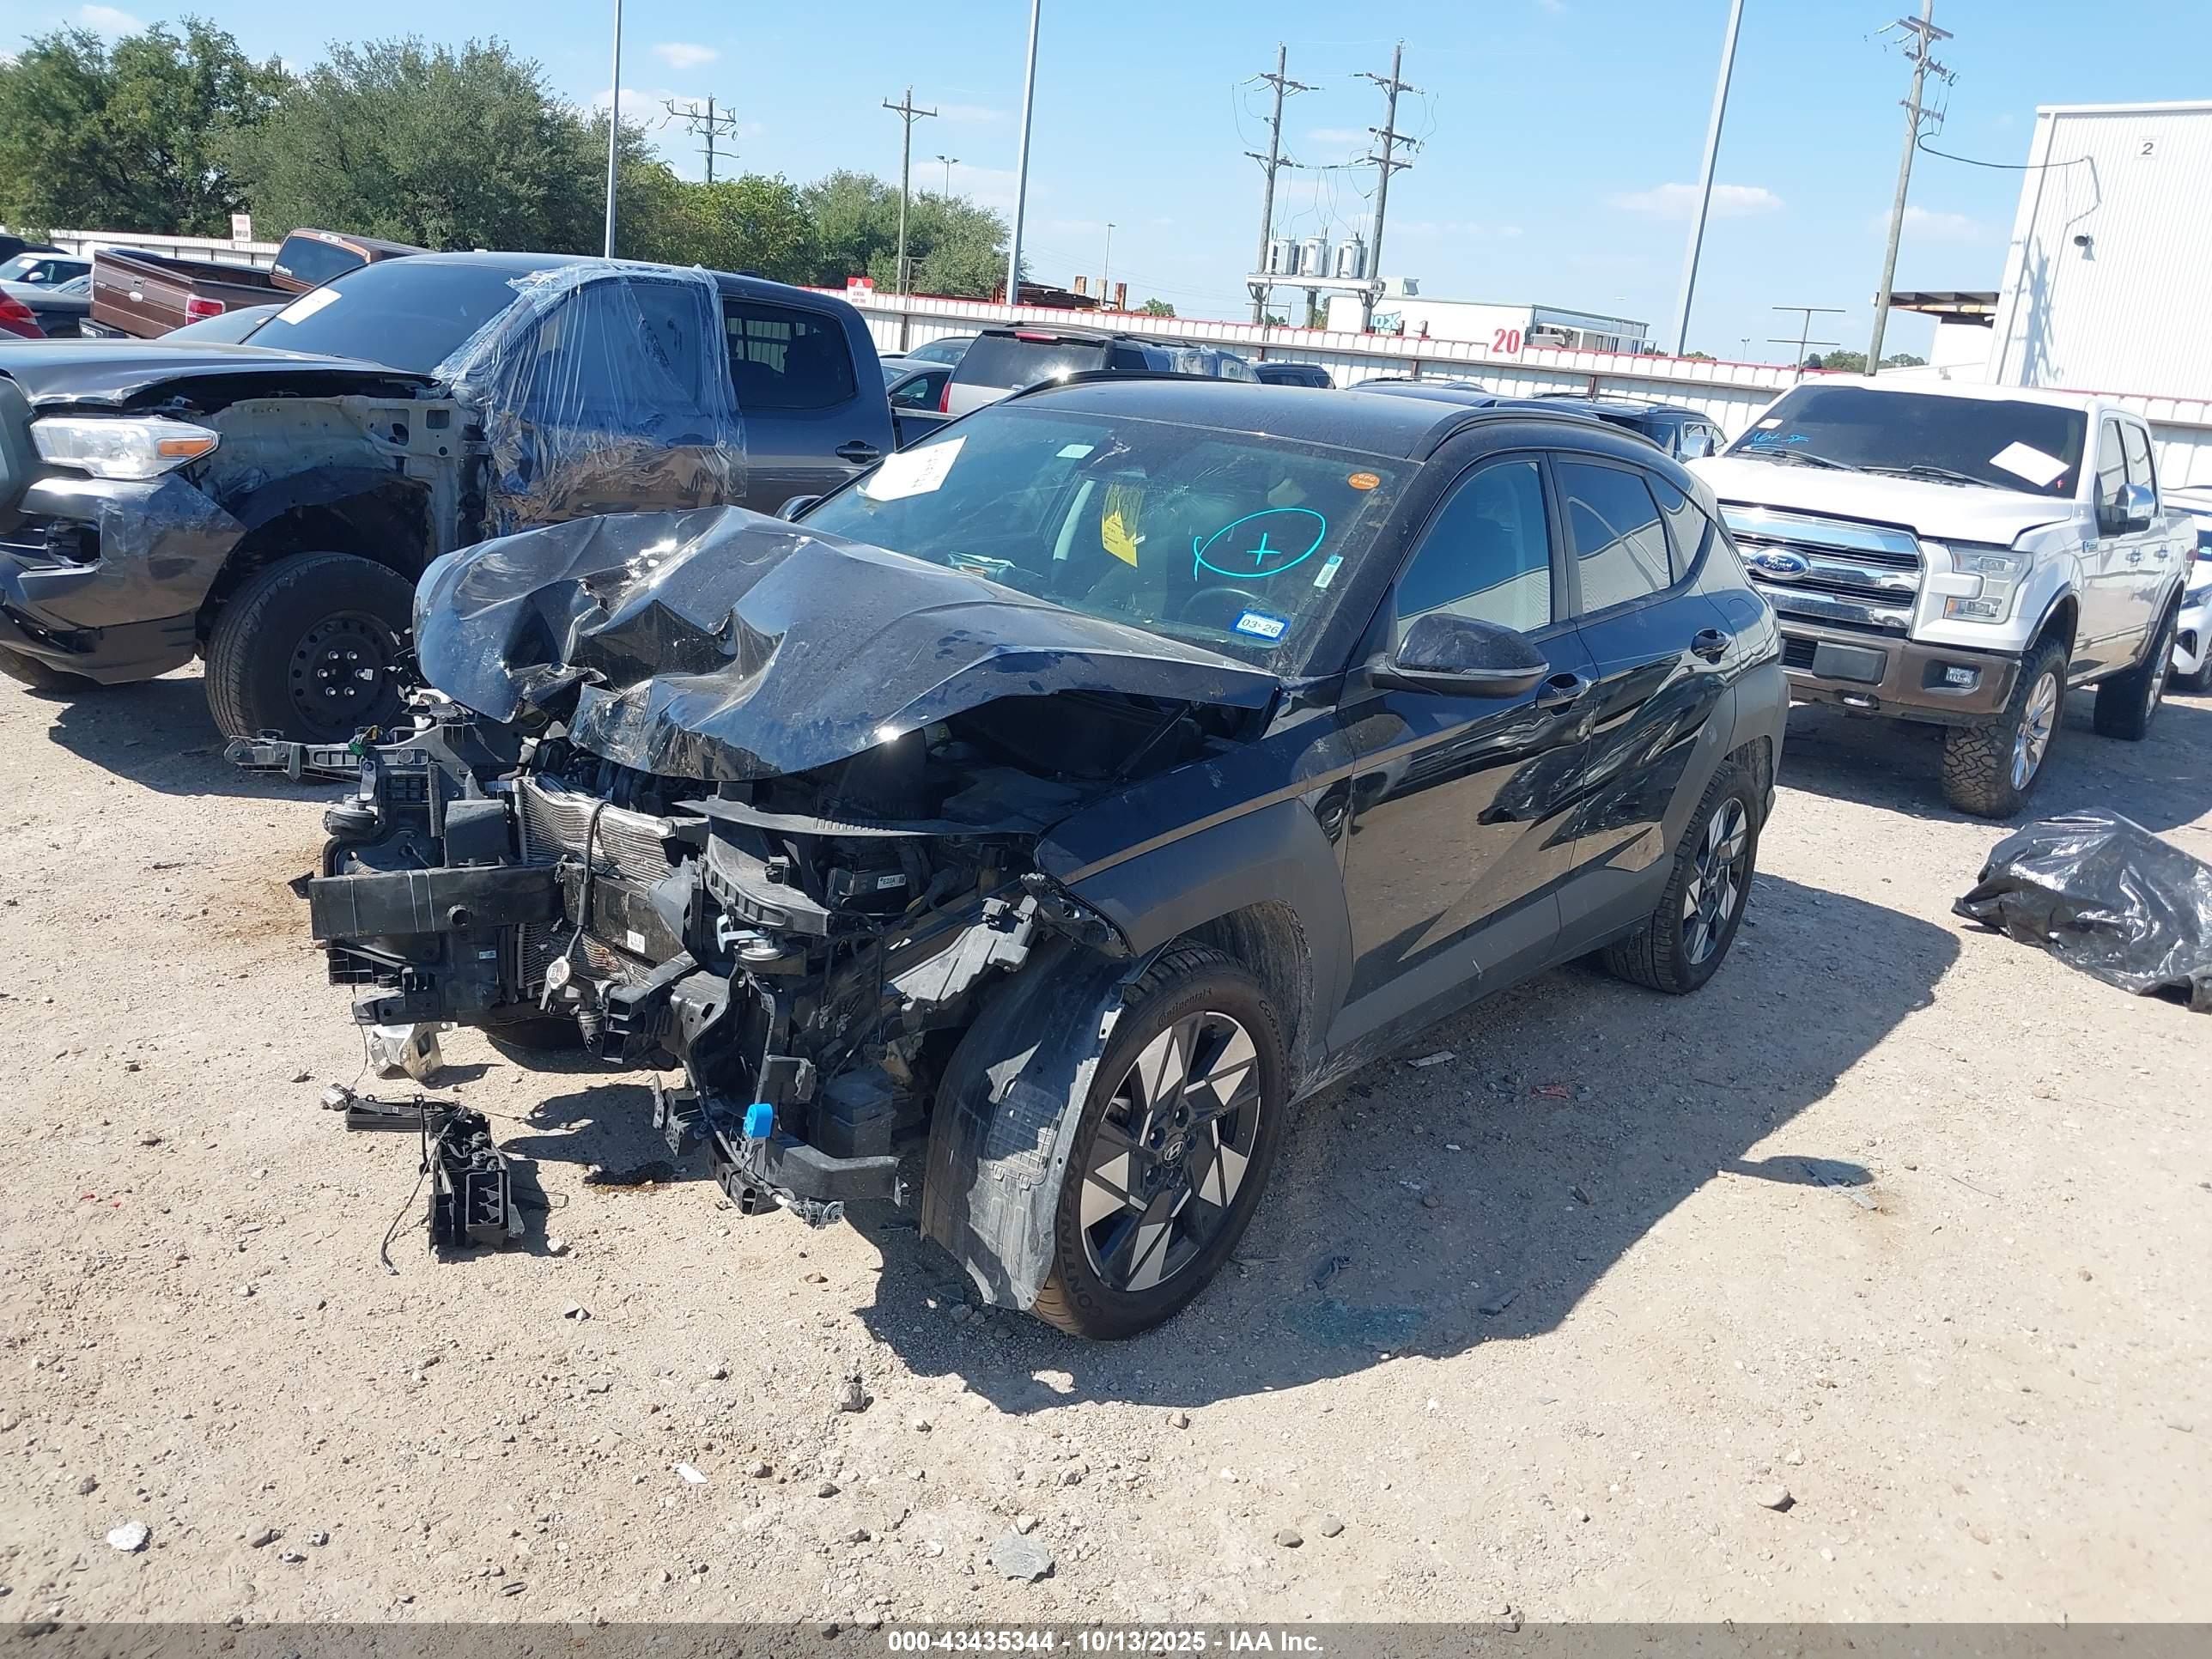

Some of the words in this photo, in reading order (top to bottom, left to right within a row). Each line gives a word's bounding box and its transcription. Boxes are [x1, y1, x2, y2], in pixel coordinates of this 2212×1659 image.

[2141, 143, 2154, 155] 2
[1492, 329, 1520, 354] 20
[1763, 555, 1795, 572] Ford
